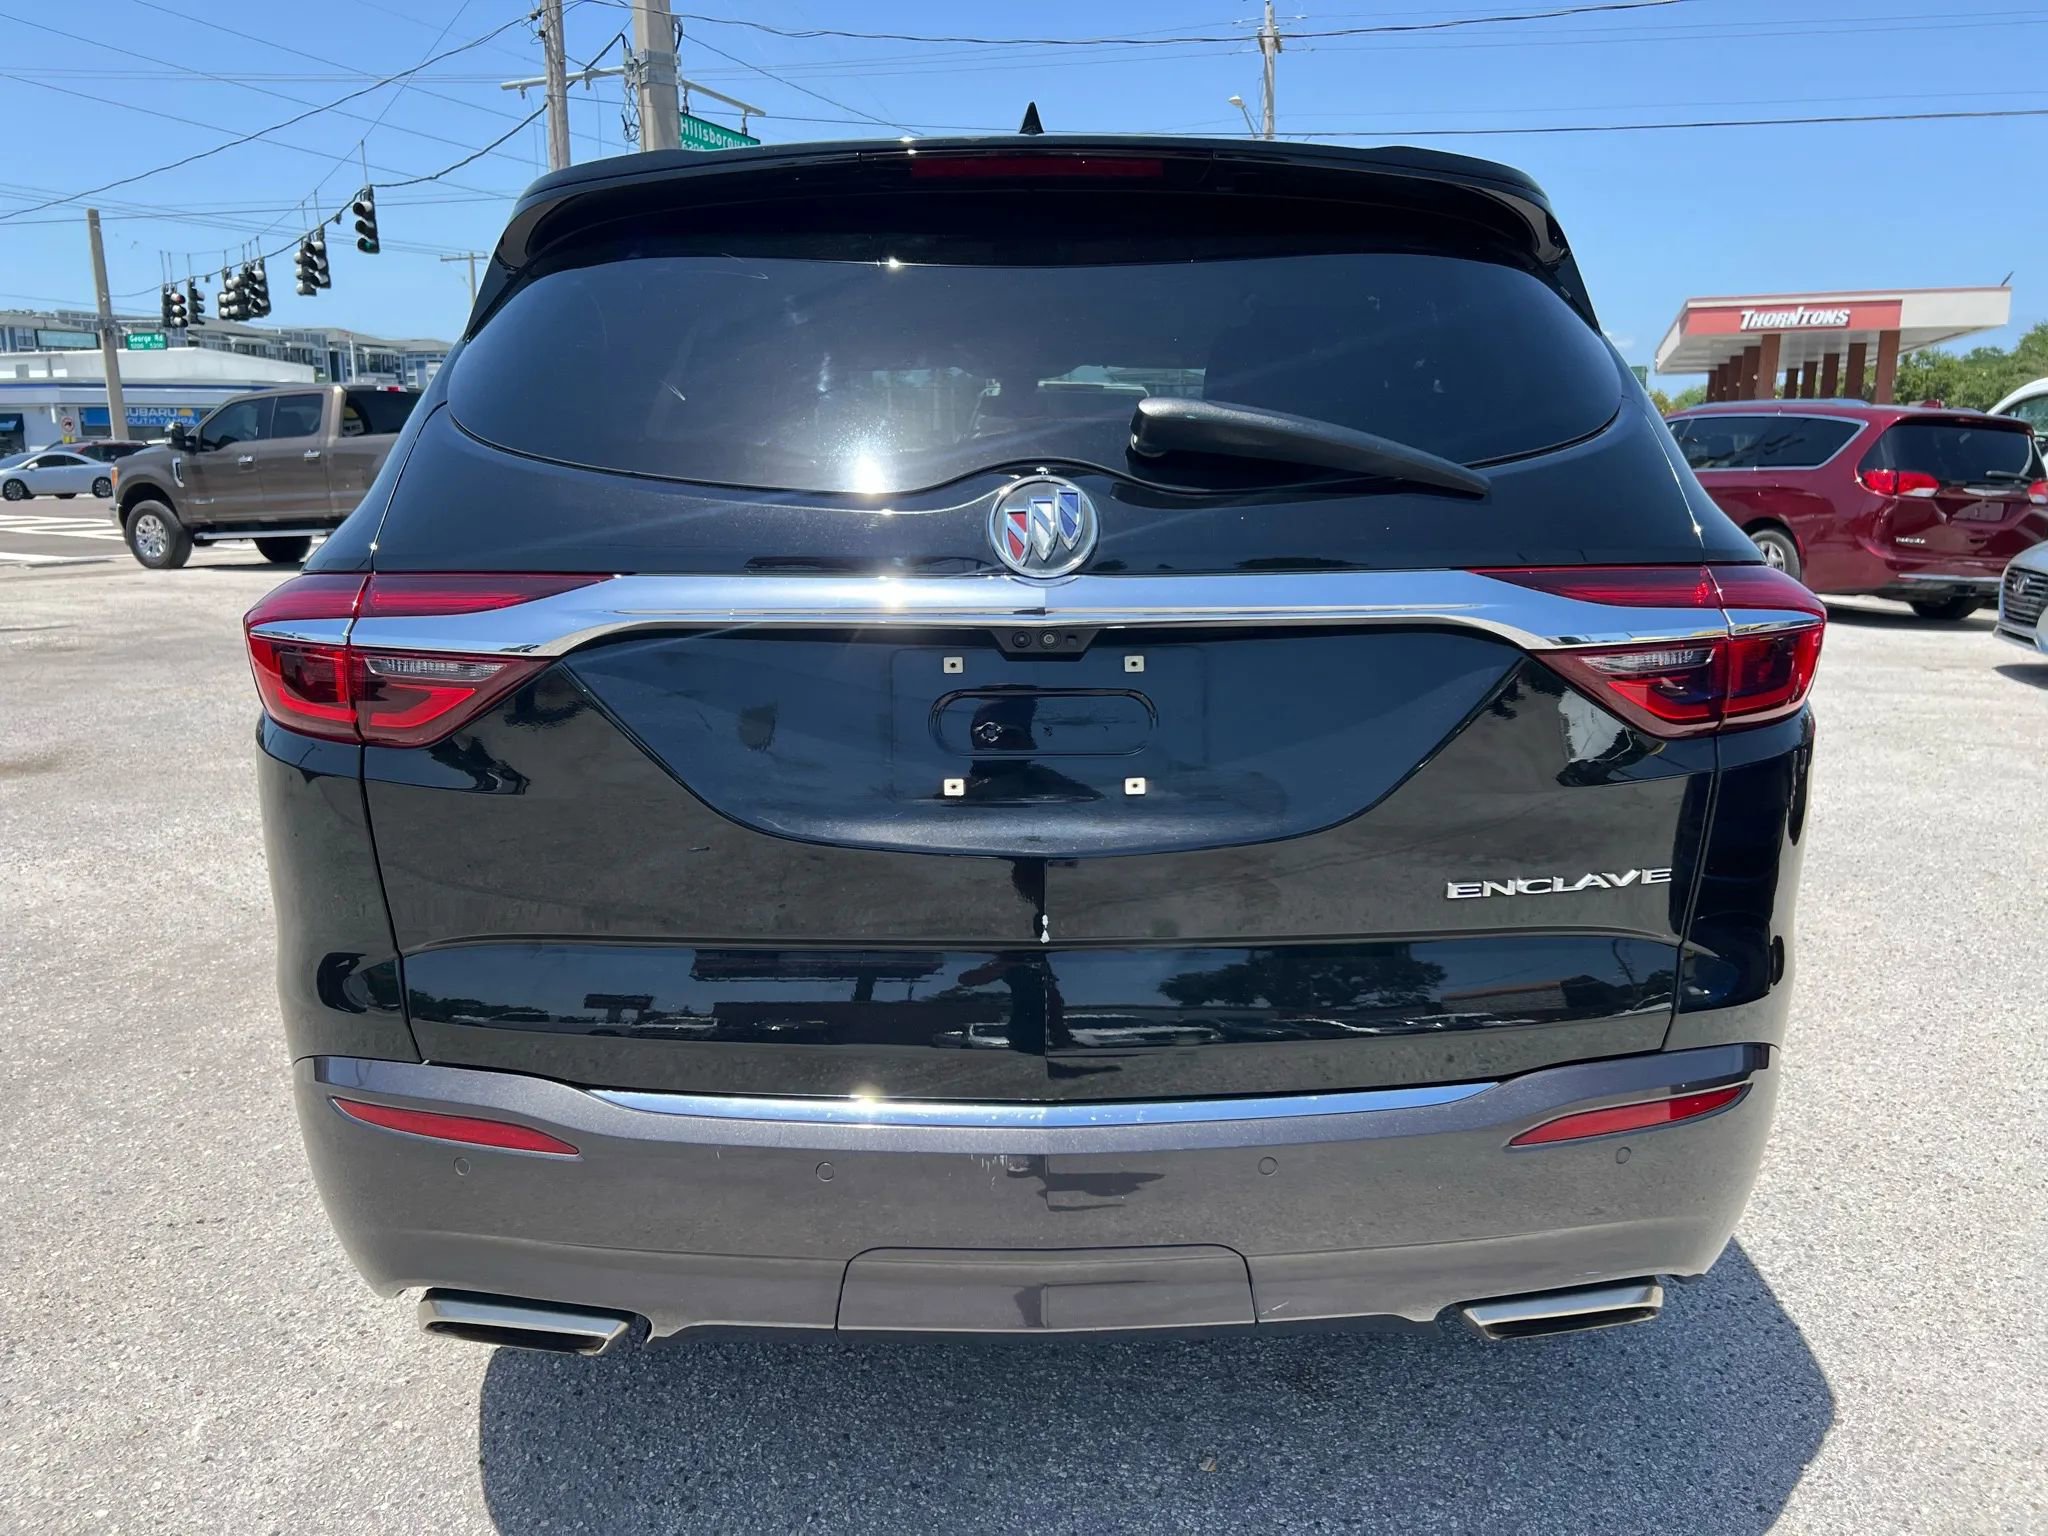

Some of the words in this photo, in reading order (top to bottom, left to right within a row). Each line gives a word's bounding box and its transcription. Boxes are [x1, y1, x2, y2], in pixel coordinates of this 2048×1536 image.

[680, 117, 751, 148] Hillsborou
[129, 335, 151, 344] George
[154, 334, 163, 342] Rd
[127, 417, 156, 425] OUTH
[1446, 868, 1672, 899] ENCLAVE
